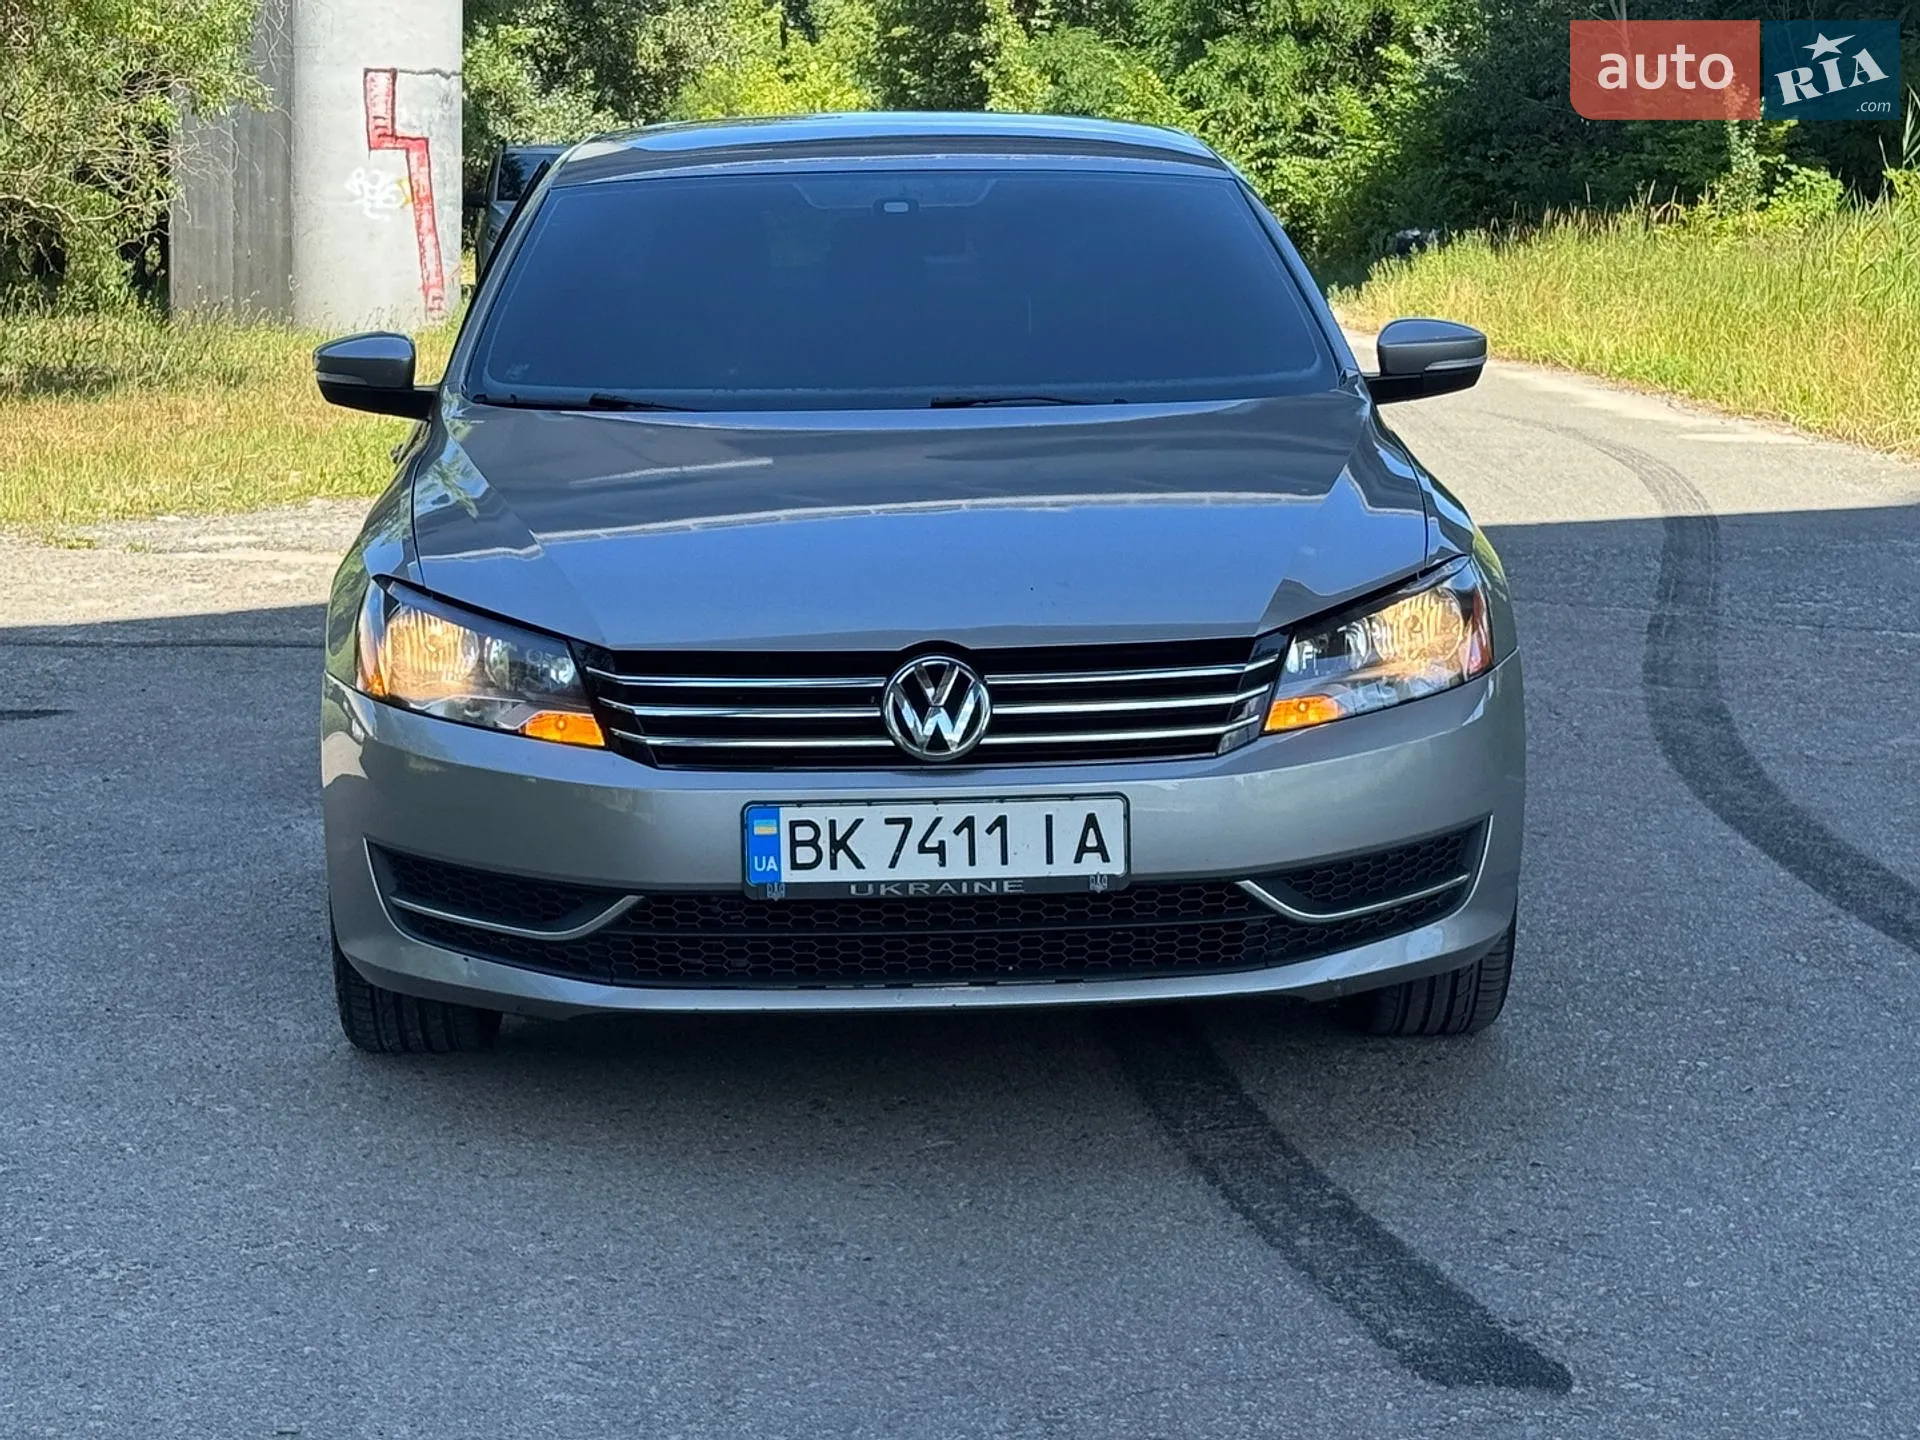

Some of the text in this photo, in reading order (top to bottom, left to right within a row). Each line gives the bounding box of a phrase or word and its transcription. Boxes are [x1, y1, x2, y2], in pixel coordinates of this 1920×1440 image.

[788, 818, 865, 871] BK
[884, 814, 1008, 869] 7411
[754, 856, 779, 872] UA
[850, 879, 1024, 897] UKRAINE
